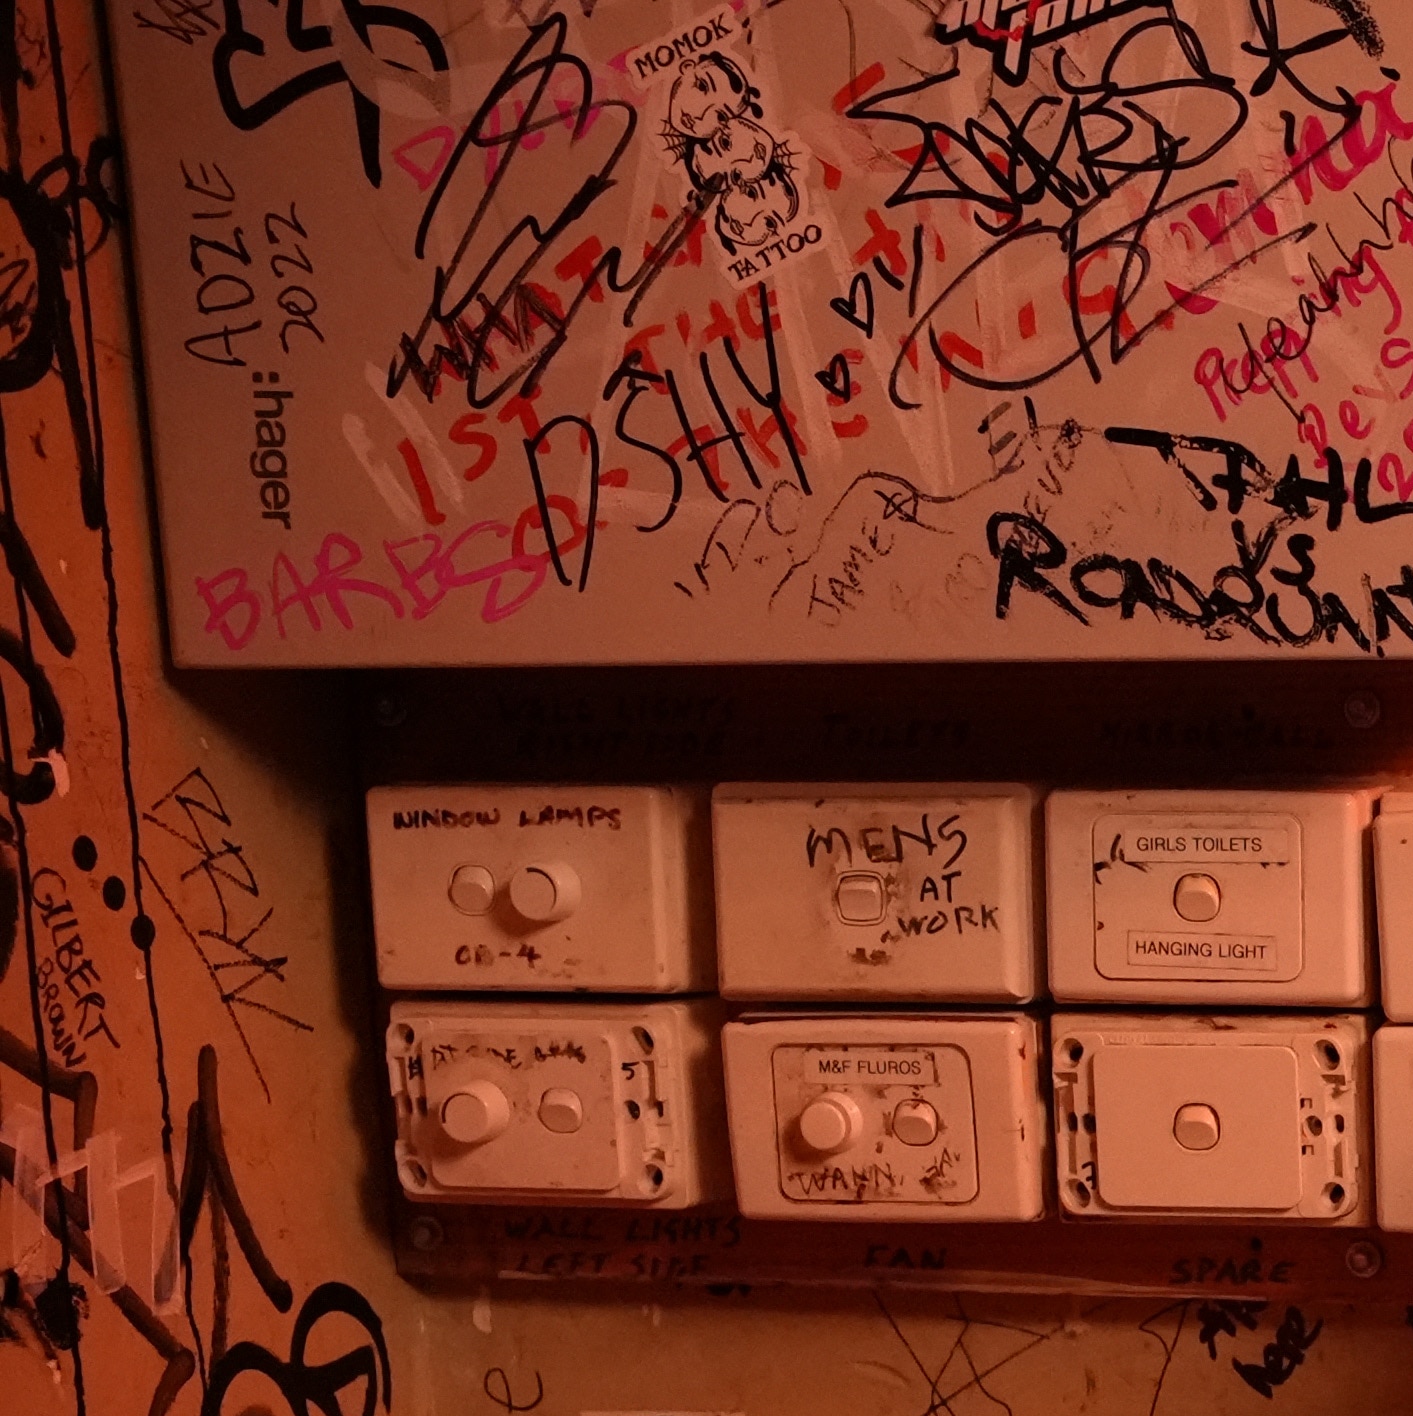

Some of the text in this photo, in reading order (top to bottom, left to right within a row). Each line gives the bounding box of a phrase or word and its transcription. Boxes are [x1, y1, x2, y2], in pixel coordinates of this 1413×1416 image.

[634, 14, 735, 80] MOMOK
[727, 222, 824, 282] TATTOO
[392, 805, 623, 832] WINDOW LAMPS
[806, 813, 969, 869] MENS
[1135, 836, 1263, 855] GIRLS TOILETS
[917, 872, 962, 903] AT
[897, 904, 1001, 938] WORK
[30, 865, 121, 1049] GILBERT
[1134, 940, 1267, 960] HANGING LIGHT
[35, 953, 88, 1069] BROWN
[818, 1059, 922, 1076] M&F FLUROS
[625, 1216, 742, 1247] LIGHTS
[864, 1244, 947, 1270] FAN
[1168, 1256, 1299, 1285] SPARE
